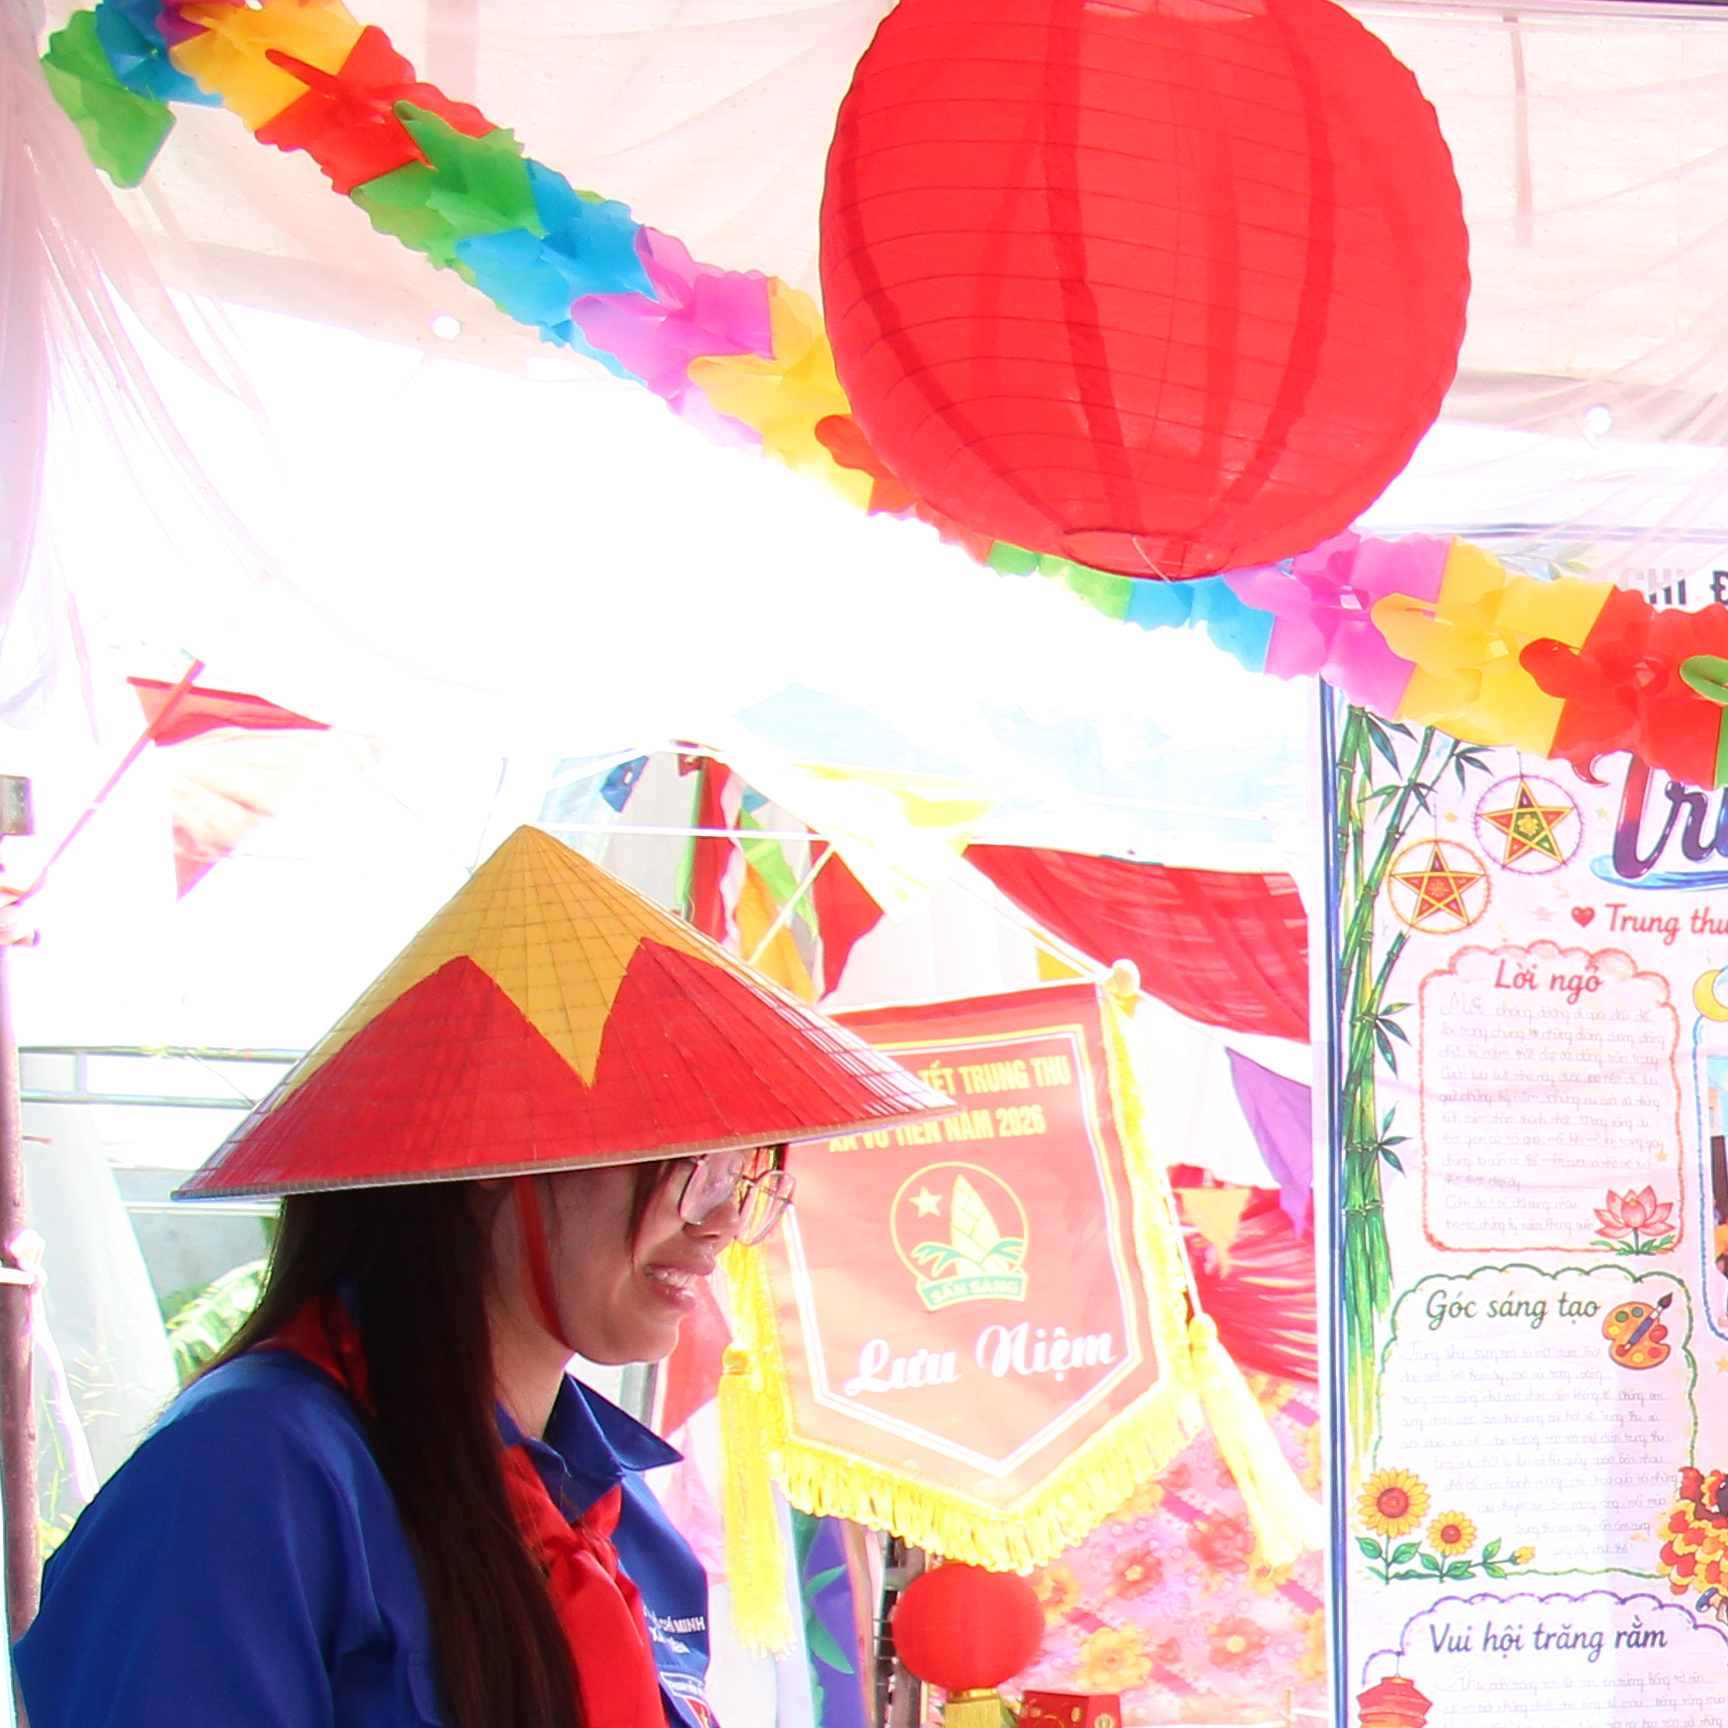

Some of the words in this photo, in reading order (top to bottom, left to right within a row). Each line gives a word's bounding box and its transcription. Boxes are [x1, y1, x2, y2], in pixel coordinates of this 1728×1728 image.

[1605, 903, 1682, 946] Trung
[1494, 959, 1539, 991] Lời
[958, 1060, 1029, 1094] TRUNG
[1029, 1055, 1071, 1087] THU
[995, 1105, 1046, 1137] 2026
[1426, 1289, 1477, 1331] Góc
[1487, 1290, 1547, 1330] sáng
[1558, 1291, 1601, 1324] tạo
[844, 1338, 962, 1396] Lưu
[976, 1322, 1116, 1382] Niệm
[1429, 1622, 1474, 1653] Vui
[1482, 1620, 1525, 1660] hội
[1533, 1621, 1605, 1663] trăng
[1614, 1614, 1668, 1649] rằm
